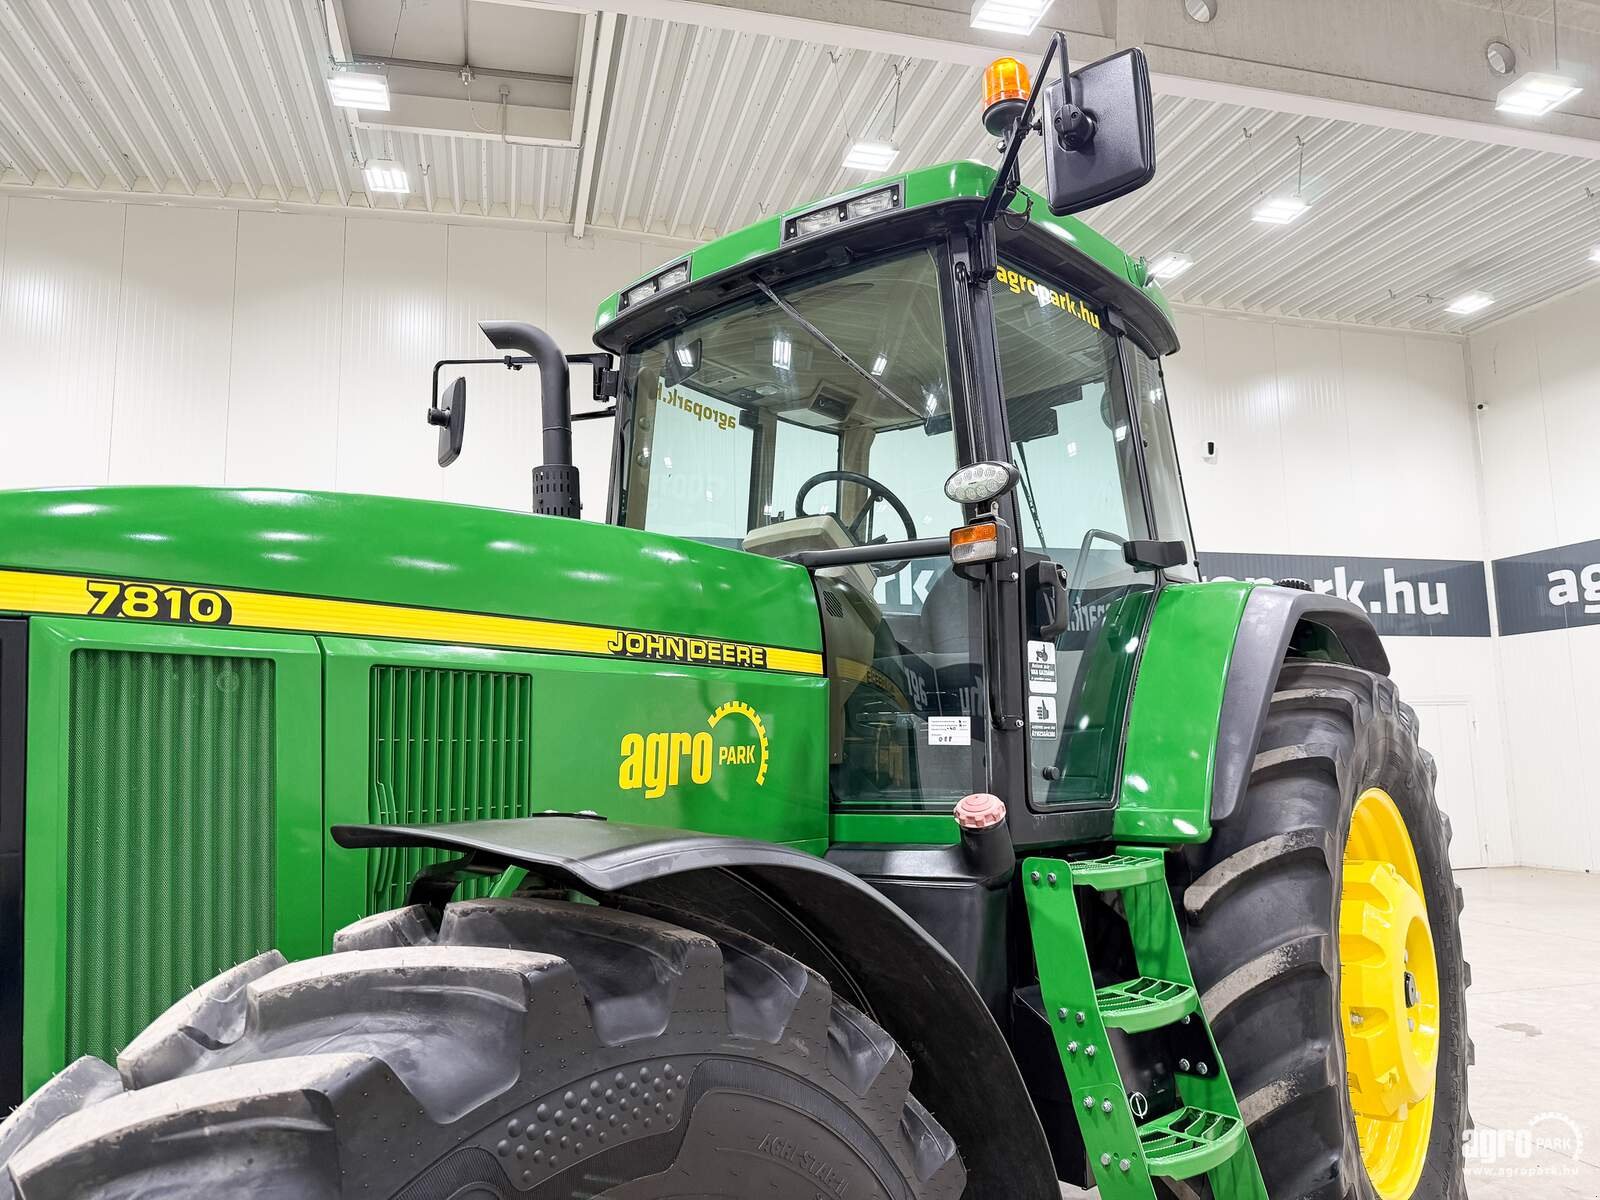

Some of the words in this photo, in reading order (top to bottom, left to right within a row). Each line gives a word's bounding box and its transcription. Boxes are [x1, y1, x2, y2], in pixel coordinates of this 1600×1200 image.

[996, 264, 1100, 330] agropark.hu
[87, 580, 232, 624] 7810
[608, 632, 686, 662] JOHN
[690, 640, 768, 668] DEERE
[619, 732, 713, 799] agro
[718, 745, 756, 766] PARK
